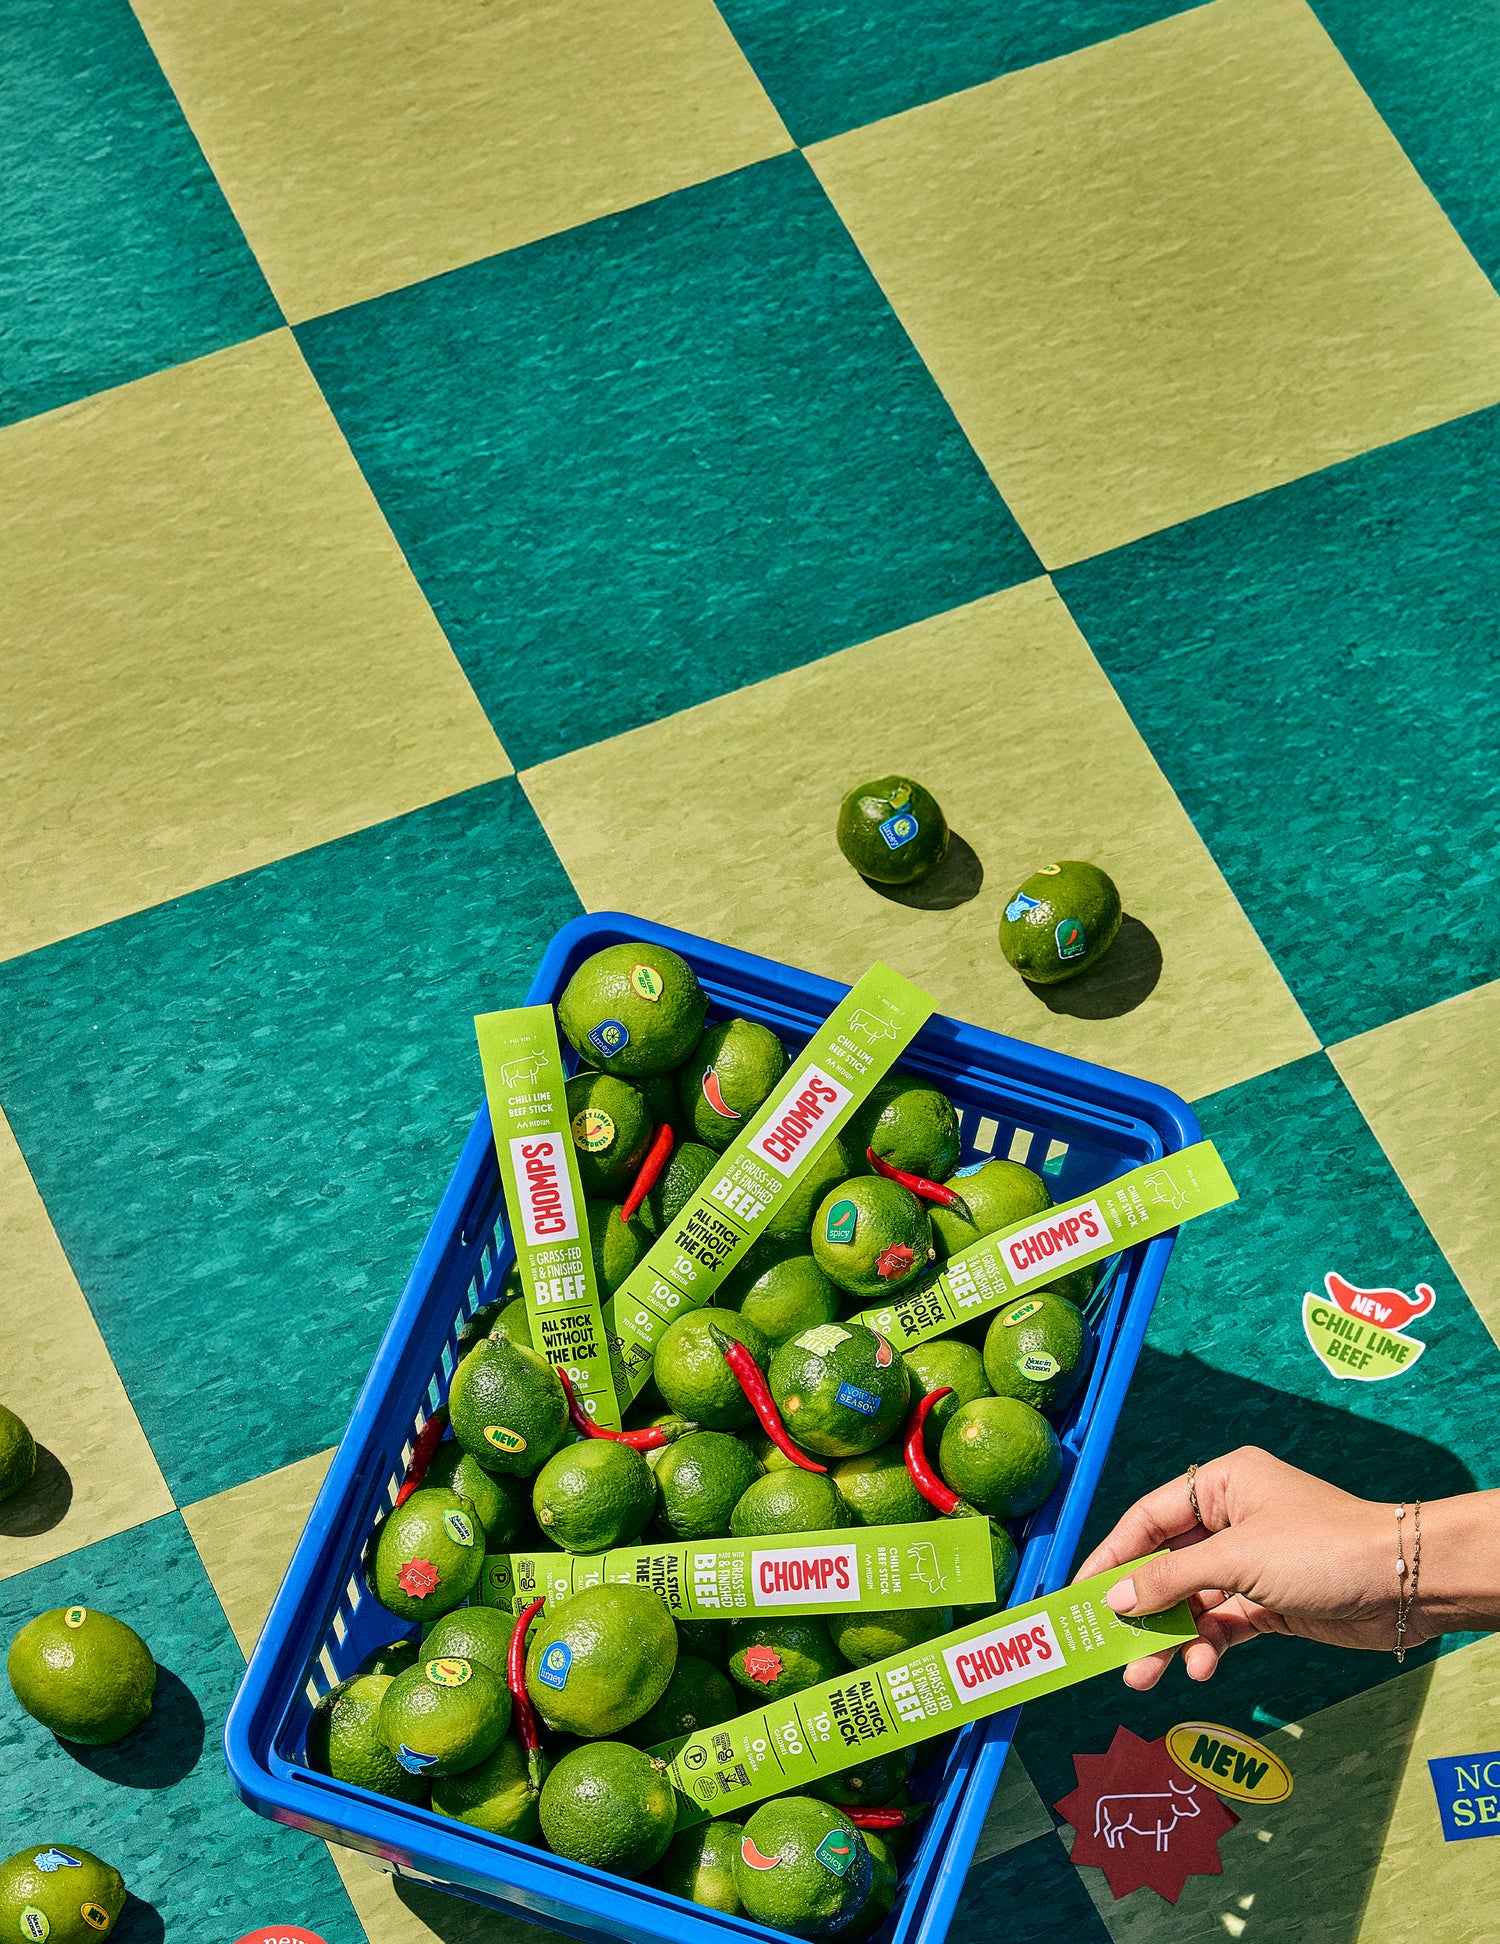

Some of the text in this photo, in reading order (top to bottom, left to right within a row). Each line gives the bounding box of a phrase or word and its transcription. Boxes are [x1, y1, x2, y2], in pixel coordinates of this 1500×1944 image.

[882, 824, 899, 845] limey
[1063, 943, 1083, 956] spicy
[591, 1032, 612, 1054] limey
[838, 1035, 874, 1066] CHILI LIME
[828, 1043, 868, 1075] BEEF STICK
[835, 1065, 855, 1081] MEDIUM
[508, 1092, 551, 1106] CHILI LIME
[509, 1103, 553, 1118] BEEF STICK
[529, 1119, 550, 1128] MEDIUM
[576, 1112, 611, 1127] SPICY LIMEY
[762, 1077, 838, 1162] CHOMPS
[578, 1135, 608, 1147] GOODNESS
[521, 1142, 567, 1235] CHOMPS
[732, 1169, 774, 1204] & FINISHED
[741, 1159, 783, 1194] GRASS-FED
[710, 1176, 766, 1223] BEEF
[1116, 1190, 1139, 1228] BEEF STICK
[1127, 1185, 1150, 1222] CHILI LIME
[693, 1208, 741, 1247] ALL STICK
[1110, 1208, 1123, 1228] MEDIUM
[685, 1218, 733, 1259] WITHOUT
[829, 1229, 851, 1238] spicy
[1009, 1210, 1099, 1271] CHOMPS
[537, 1247, 582, 1265] GRASS-FED
[675, 1230, 724, 1272] THE ICK
[539, 1261, 584, 1279] & FINISHED
[668, 1269, 689, 1286] PROTEIN
[673, 1255, 697, 1281] 10G
[969, 1260, 995, 1300] & FINISHED
[982, 1254, 1007, 1294] GRASS-FED
[534, 1274, 586, 1306] BEEF
[650, 1280, 680, 1308] 100
[946, 1261, 983, 1308] BEEF
[647, 1295, 670, 1314] CALORIES
[924, 1288, 946, 1324] STICK
[1011, 1303, 1035, 1321] NEW
[1350, 1293, 1393, 1323] NEW
[542, 1313, 593, 1333] ALL STICK
[623, 1318, 637, 1332] TOTAL
[636, 1328, 653, 1343] SUGAR
[635, 1311, 654, 1332] 0G
[876, 1308, 892, 1335] 10G
[897, 1309, 920, 1338] ICK
[543, 1328, 594, 1348] WITHOUT
[1311, 1308, 1410, 1365] CHILI LIME
[545, 1343, 598, 1365] THE ICK
[1024, 1363, 1051, 1373] Season
[1326, 1338, 1373, 1370] BEEF
[566, 1367, 589, 1382] 0G
[840, 1393, 876, 1413] SEASON
[845, 1386, 868, 1400] NOW
[492, 1430, 521, 1449] NEW
[636, 1556, 651, 1583] THE
[667, 1555, 683, 1610] ALL STICK
[694, 1554, 721, 1609] BEEF
[718, 1560, 734, 1608] & FINISHED
[732, 1559, 747, 1608] GRASS-FED
[760, 1555, 850, 1594] CHOMPS
[866, 1568, 874, 1590] MEDIUM
[877, 1547, 890, 1595] BEEF STICK
[889, 1547, 902, 1593] CHILI LIME
[554, 1579, 568, 1601] 0G
[71, 1610, 82, 1623] NEW
[1070, 1604, 1094, 1652] BEEF STICK
[1082, 1601, 1106, 1647] CHILI LIME
[1064, 1629, 1077, 1652] MEDIUM
[955, 1626, 1052, 1689] CHOMPS
[540, 1668, 564, 1686] limey
[911, 1667, 939, 1716] & FINISHED
[925, 1662, 953, 1711] GRASS-FED
[860, 1681, 889, 1736] ALL STICK
[886, 1665, 926, 1723] BEEF
[814, 1711, 831, 1742] 10G
[828, 1689, 861, 1747] THE ICK
[845, 1684, 876, 1740] WITHOUT
[774, 1729, 788, 1756] CALORIES
[781, 1720, 803, 1755] 100
[806, 1718, 819, 1743] PROTEIN
[743, 1735, 751, 1755] TOTAL
[748, 1754, 759, 1773] SUGAR
[752, 1738, 767, 1762] 0G
[1189, 1734, 1269, 1790] NEW
[820, 1849, 845, 1872] spicy
[88, 1906, 107, 1925] NEW
